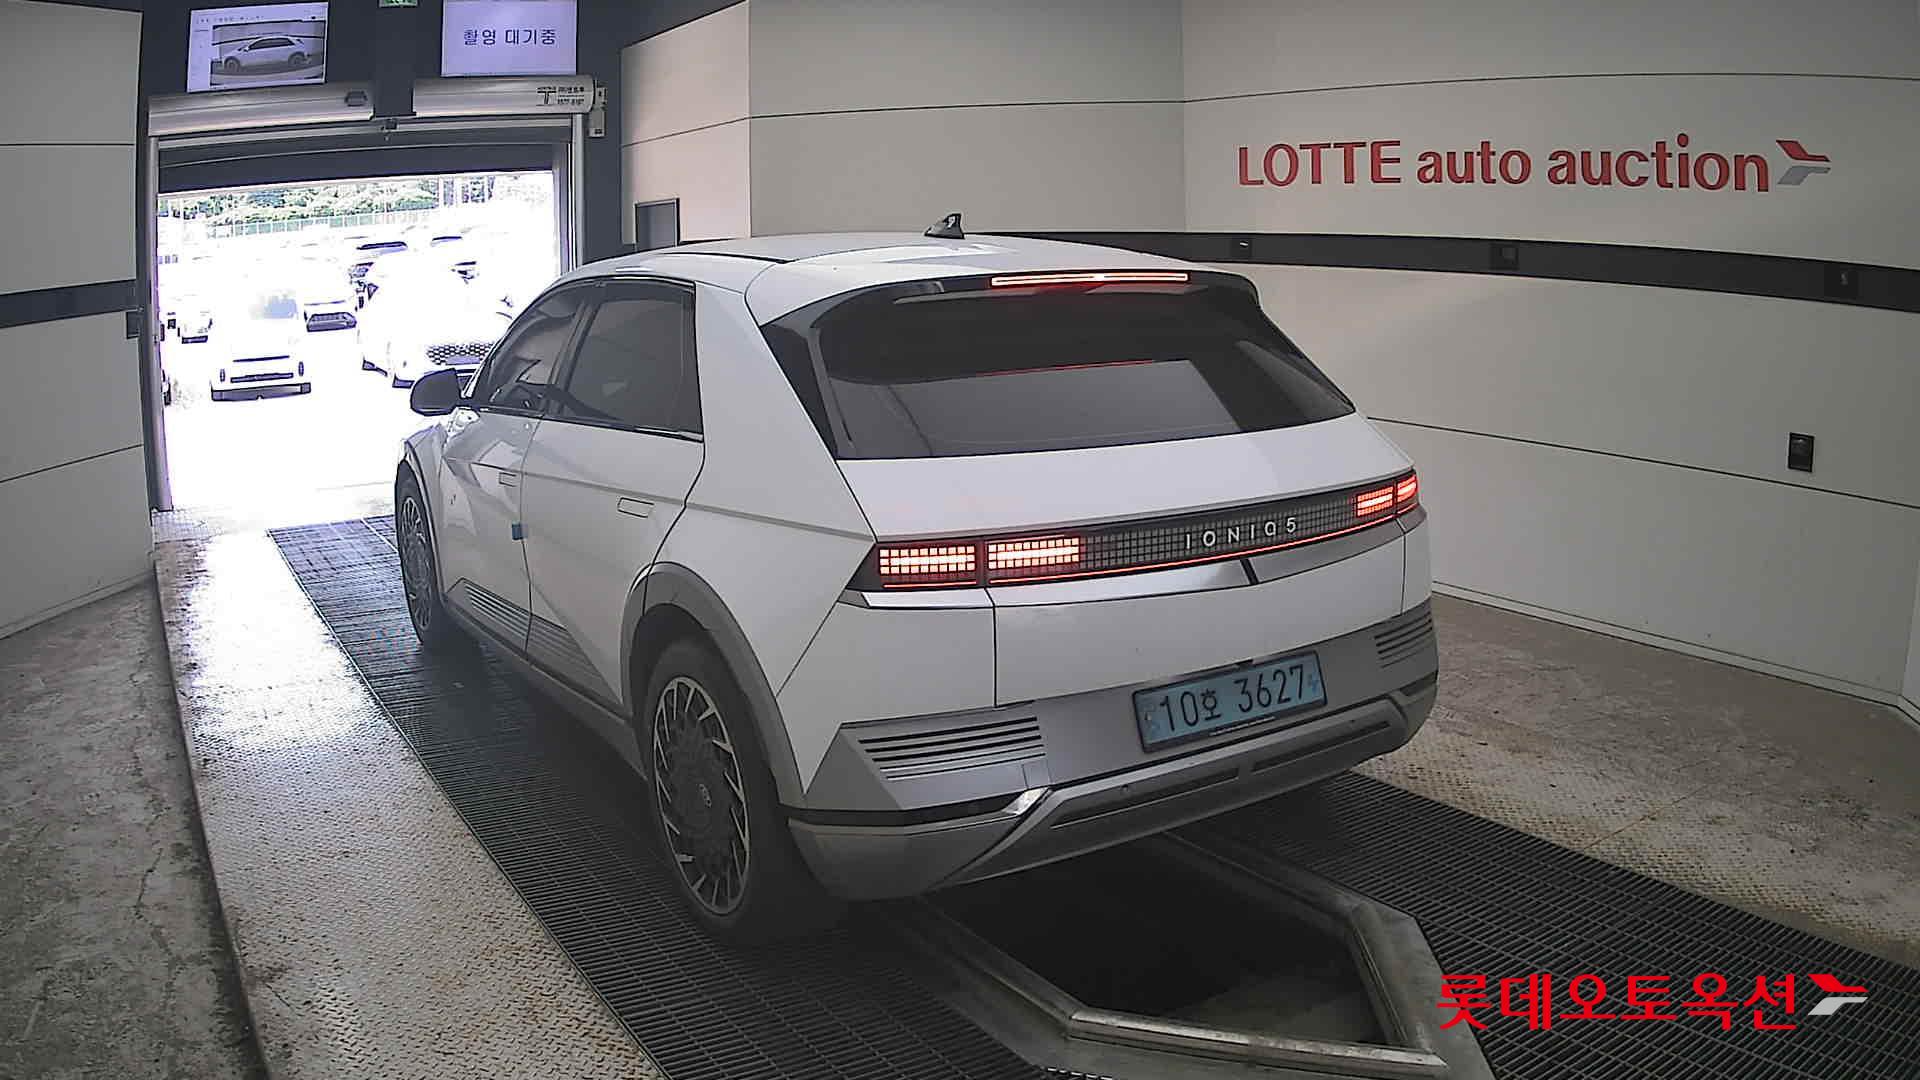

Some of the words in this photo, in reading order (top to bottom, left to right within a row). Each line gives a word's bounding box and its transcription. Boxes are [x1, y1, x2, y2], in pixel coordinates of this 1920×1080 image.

[505, 29, 556, 46] 대기중
[1238, 140, 1401, 187] LOTTE
[1416, 140, 1532, 186] auto
[1547, 132, 1770, 193] auction
[1159, 688, 1222, 732] 10호
[1233, 663, 1304, 713] 3627
